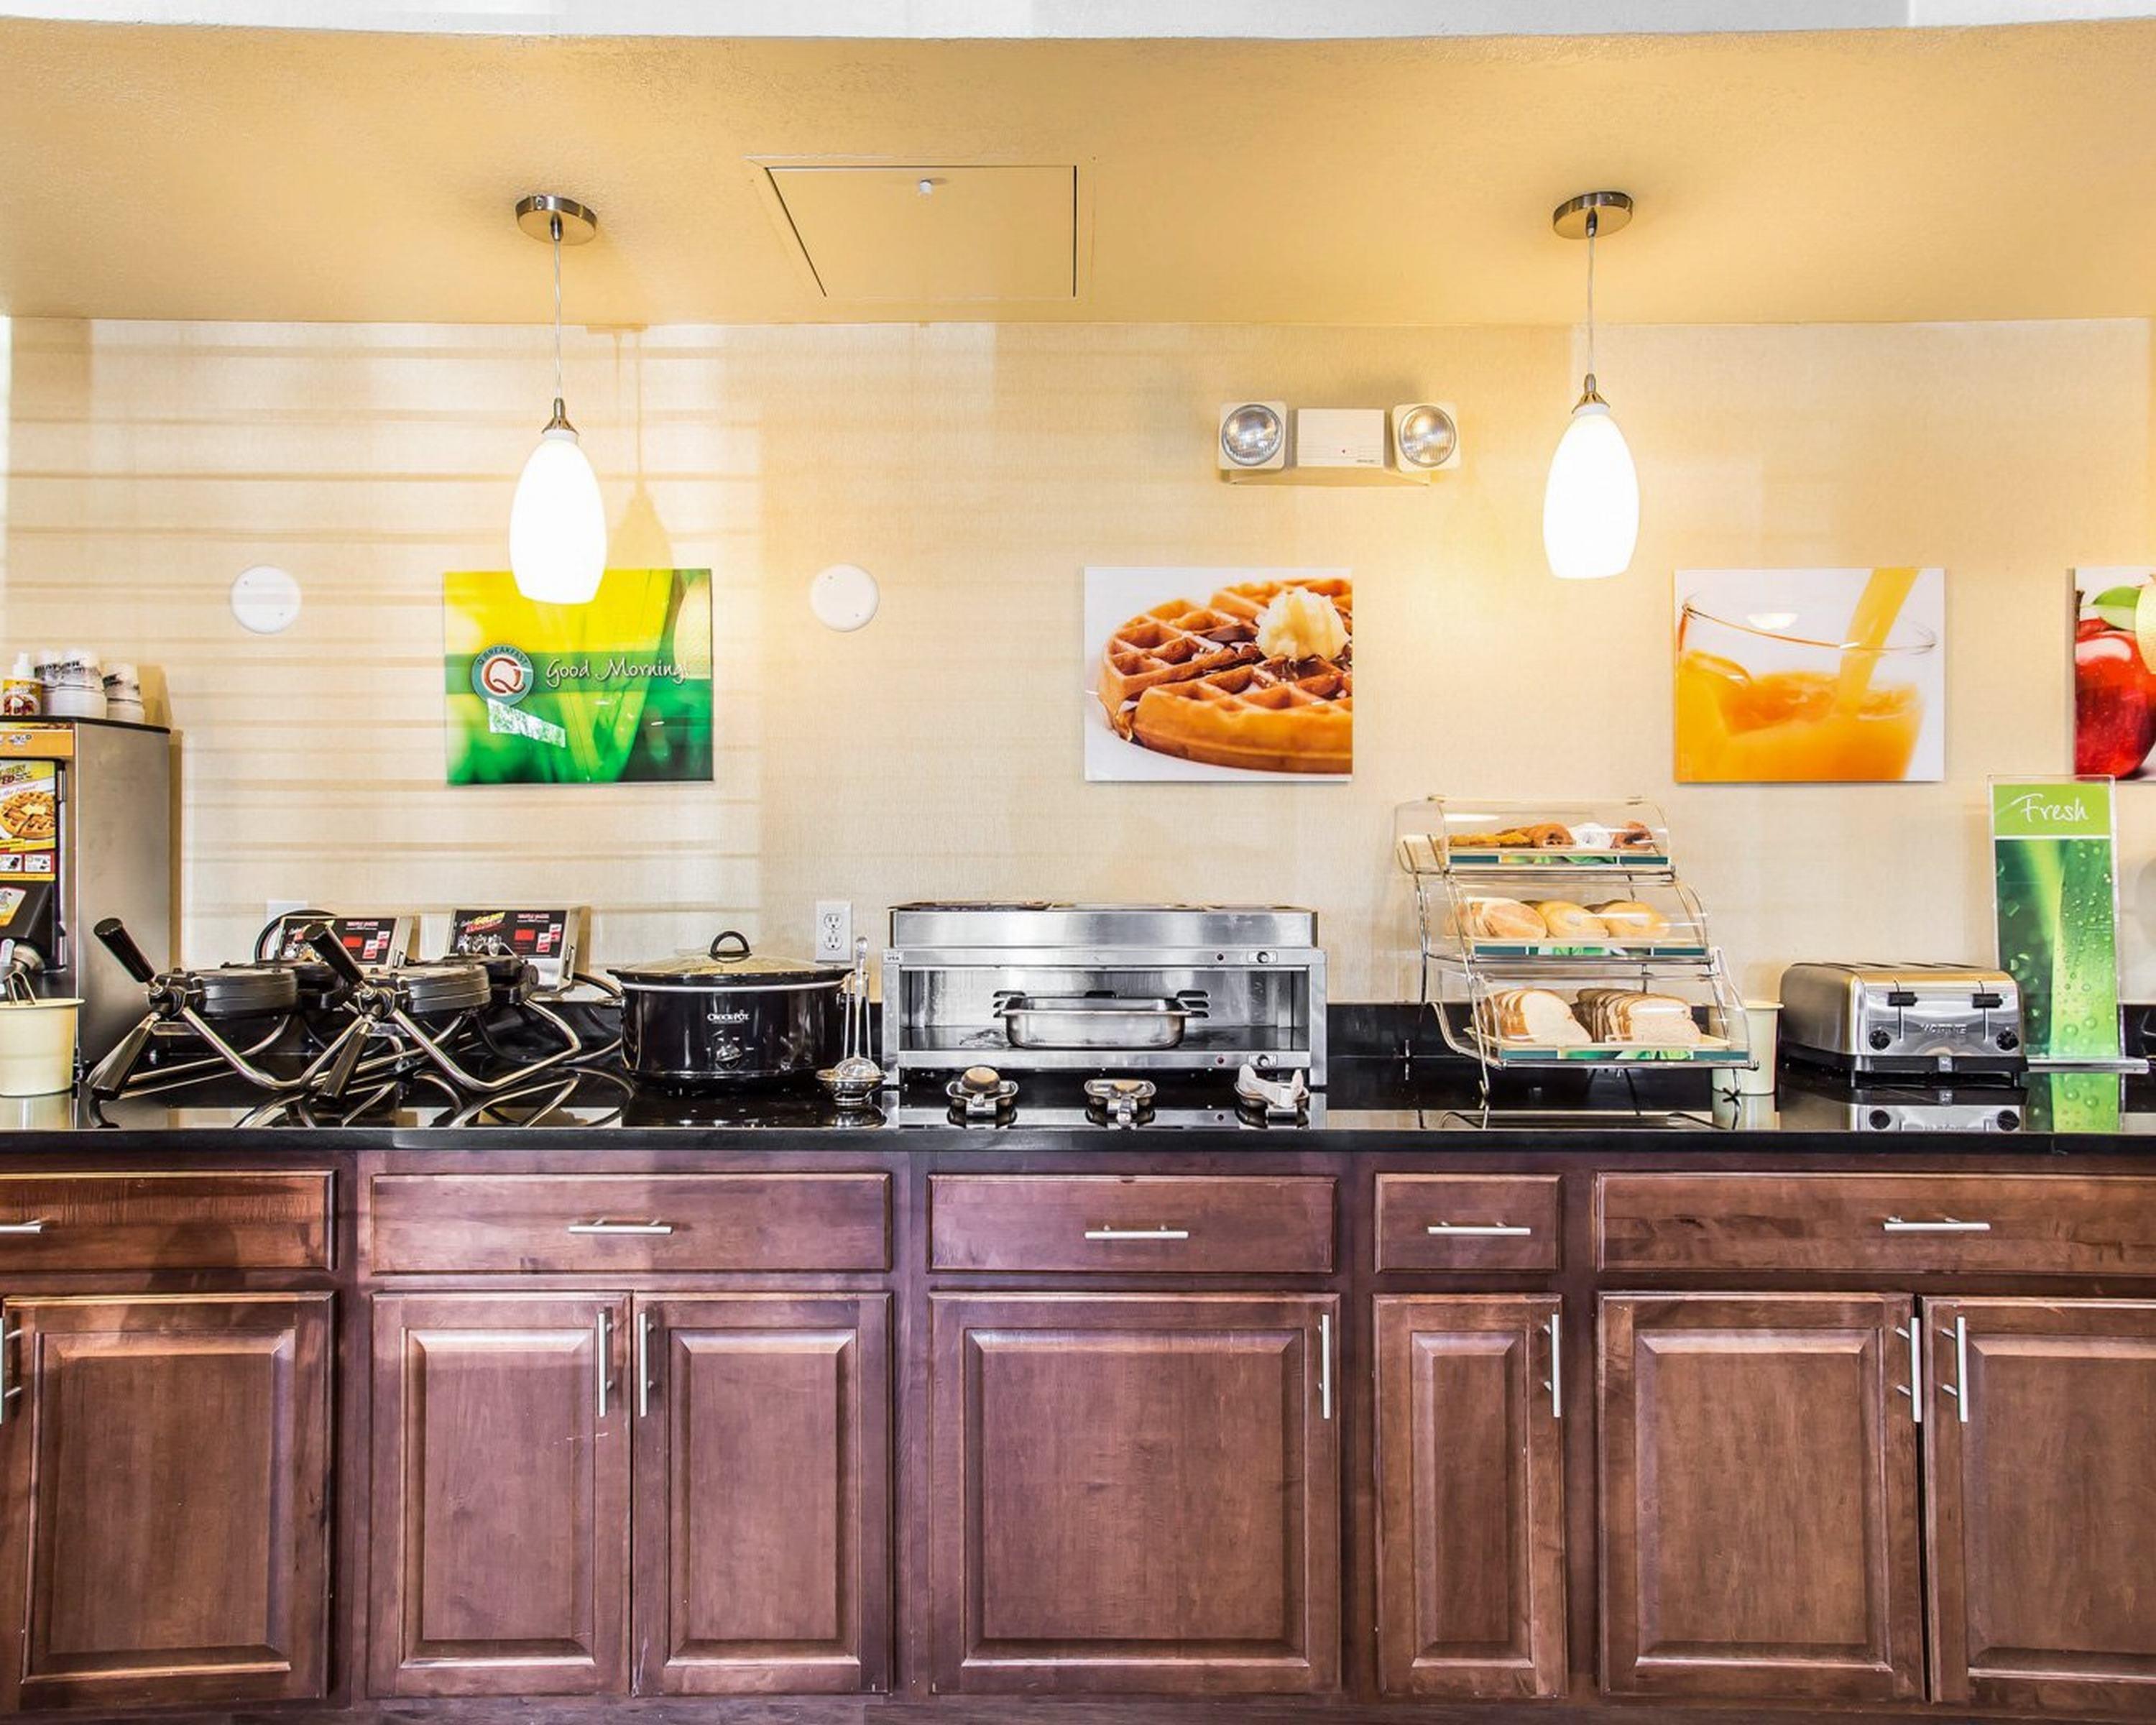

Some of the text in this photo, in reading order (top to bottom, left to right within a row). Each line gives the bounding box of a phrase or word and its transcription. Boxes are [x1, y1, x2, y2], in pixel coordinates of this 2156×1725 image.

[484, 647, 528, 664] BREAKFAST
[484, 658, 526, 693] Q
[546, 658, 589, 688] Good
[2010, 793, 2089, 823] Fresh
